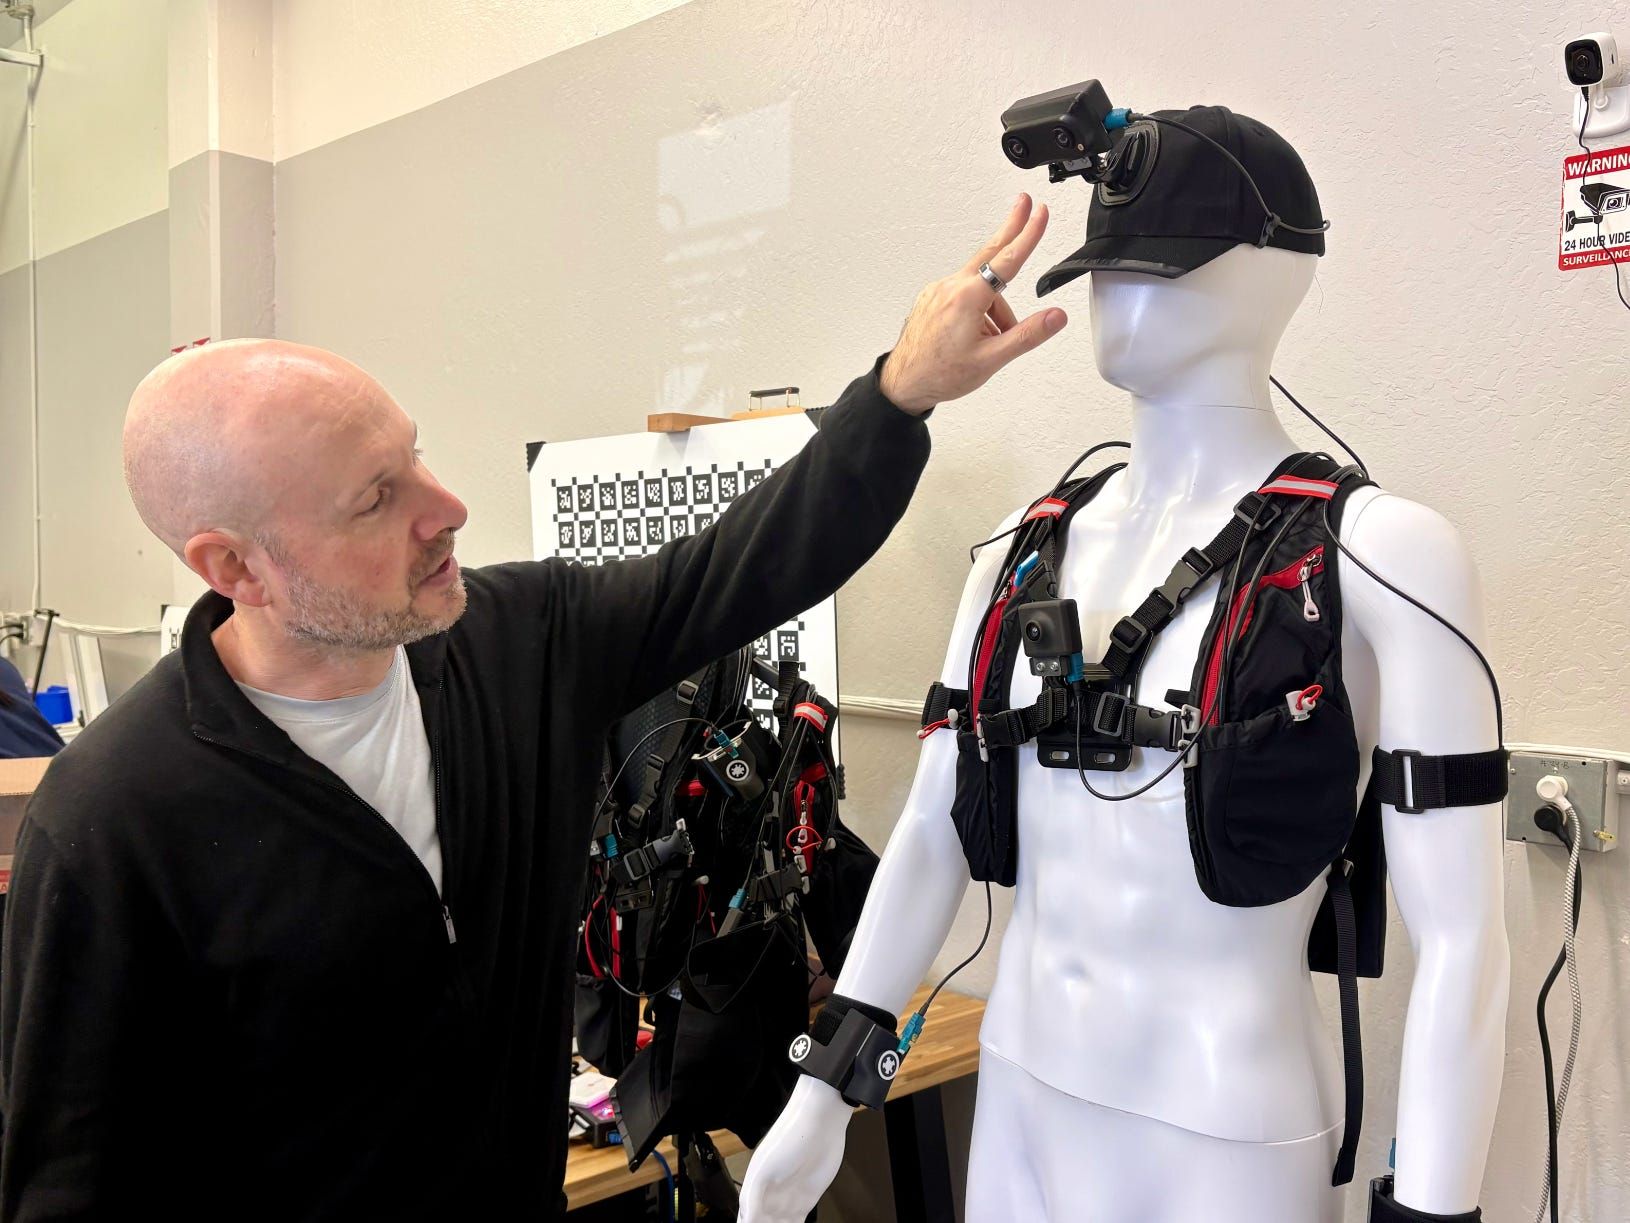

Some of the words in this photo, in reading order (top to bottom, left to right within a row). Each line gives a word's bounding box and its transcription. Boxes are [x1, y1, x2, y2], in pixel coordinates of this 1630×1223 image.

[1567, 152, 1630, 177] WARNIN
[1564, 239, 1576, 252] 24
[1579, 235, 1606, 250] HOUR
[1563, 249, 1630, 266] SURVEILLANC
